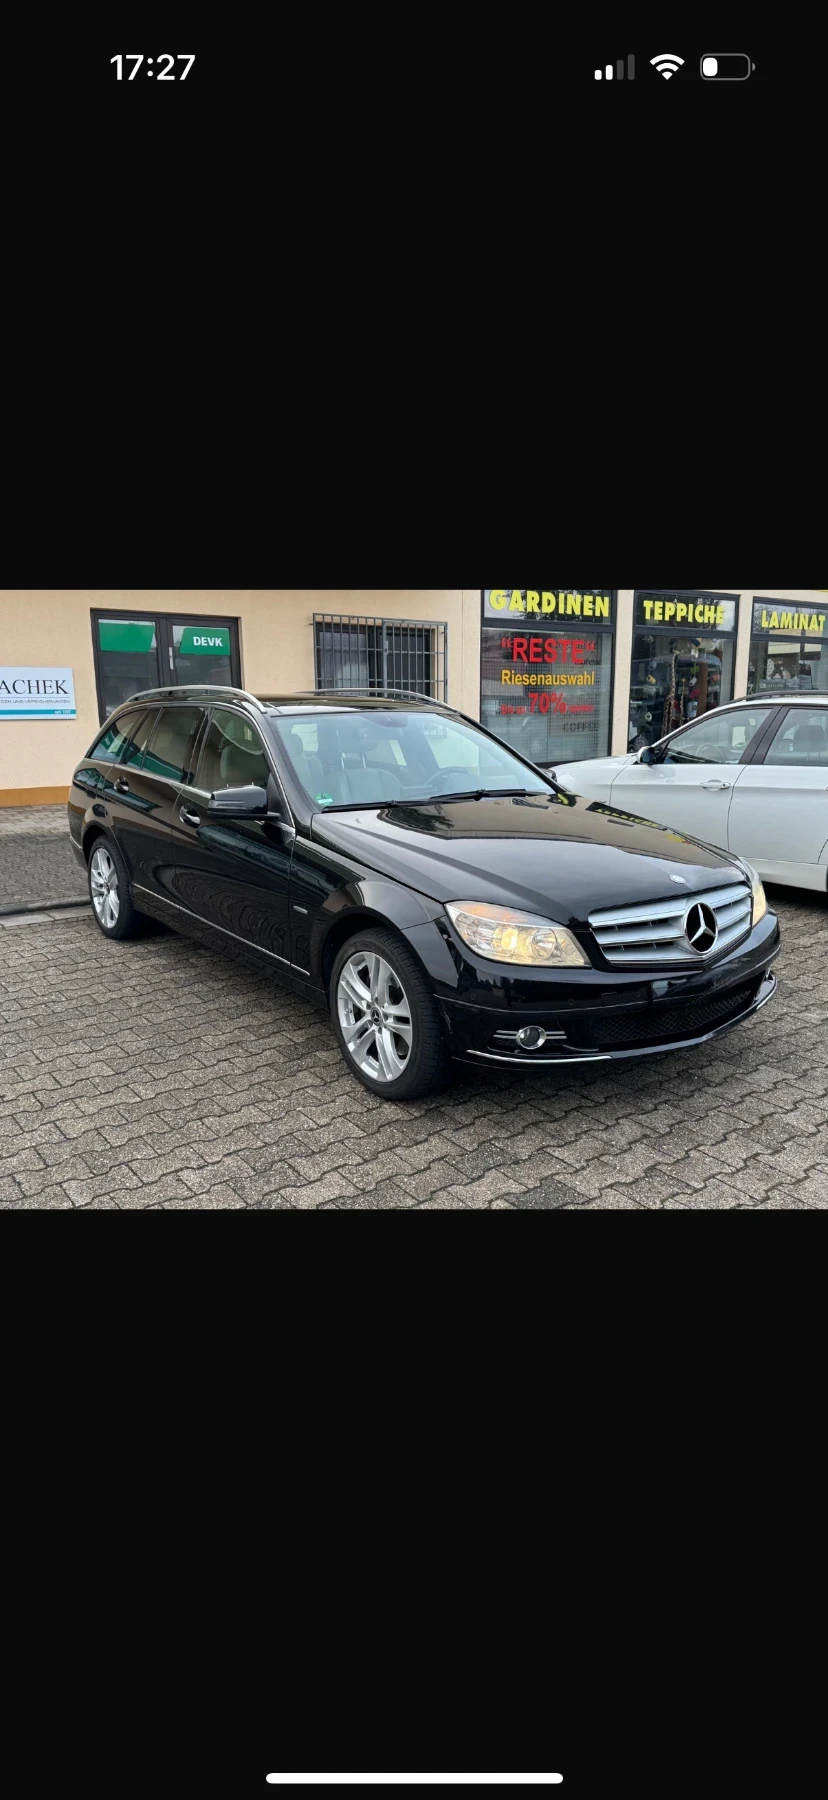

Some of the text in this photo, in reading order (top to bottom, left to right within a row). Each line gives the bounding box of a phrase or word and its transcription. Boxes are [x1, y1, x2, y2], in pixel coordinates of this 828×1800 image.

[489, 589, 609, 617] GARDINEN
[643, 600, 724, 624] TEPPICHE
[761, 610, 825, 632] LAMINAT
[193, 636, 223, 647] DEVK
[501, 669, 595, 686] Riesenauswahl
[528, 692, 567, 714] 70%
